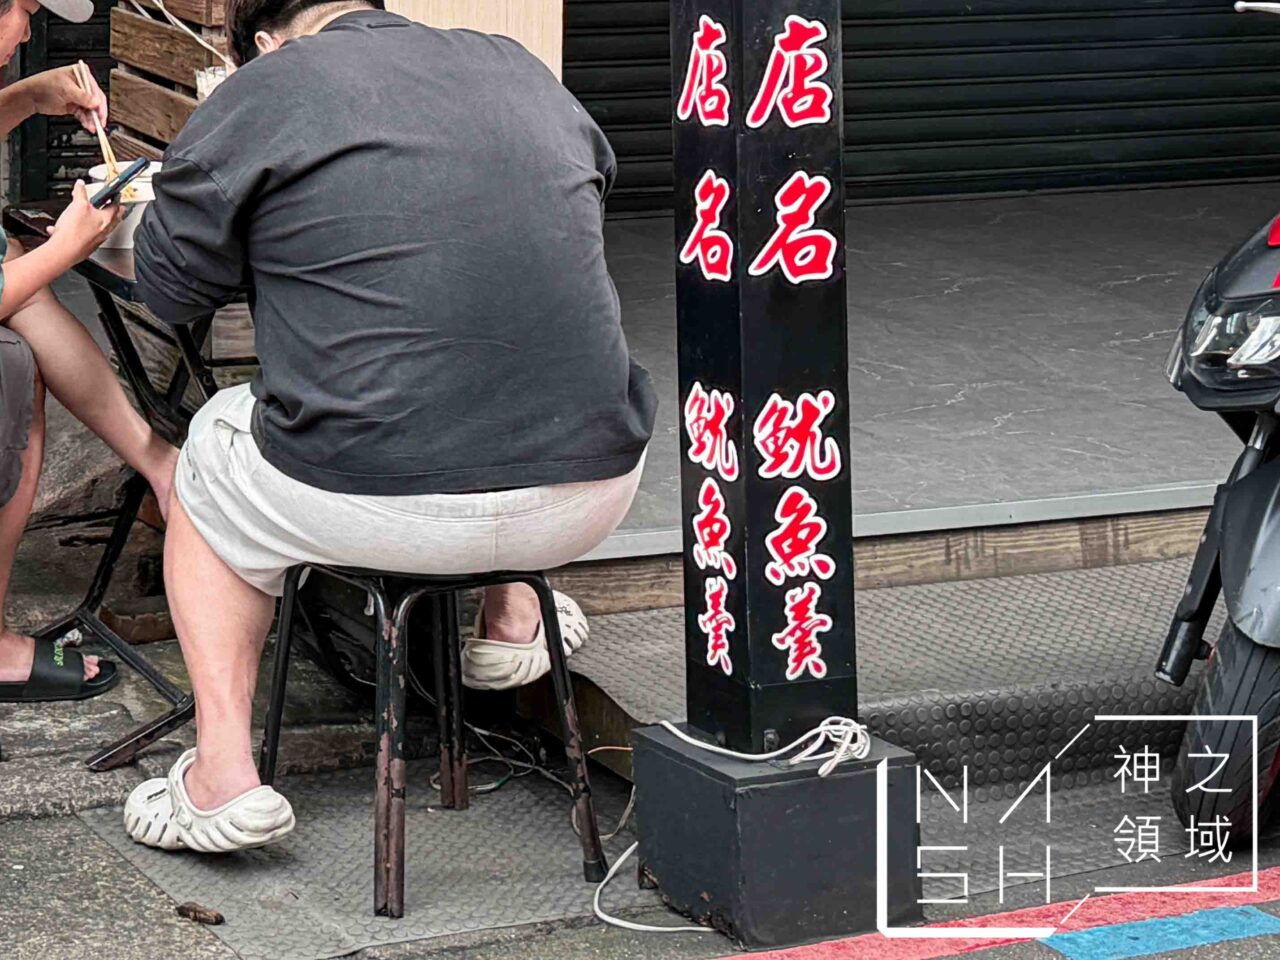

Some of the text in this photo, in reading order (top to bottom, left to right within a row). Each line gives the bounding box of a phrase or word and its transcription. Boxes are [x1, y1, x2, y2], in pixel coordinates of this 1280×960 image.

[684, 381, 739, 676] 魷魚羹
[753, 389, 842, 681] 魷魚羹
